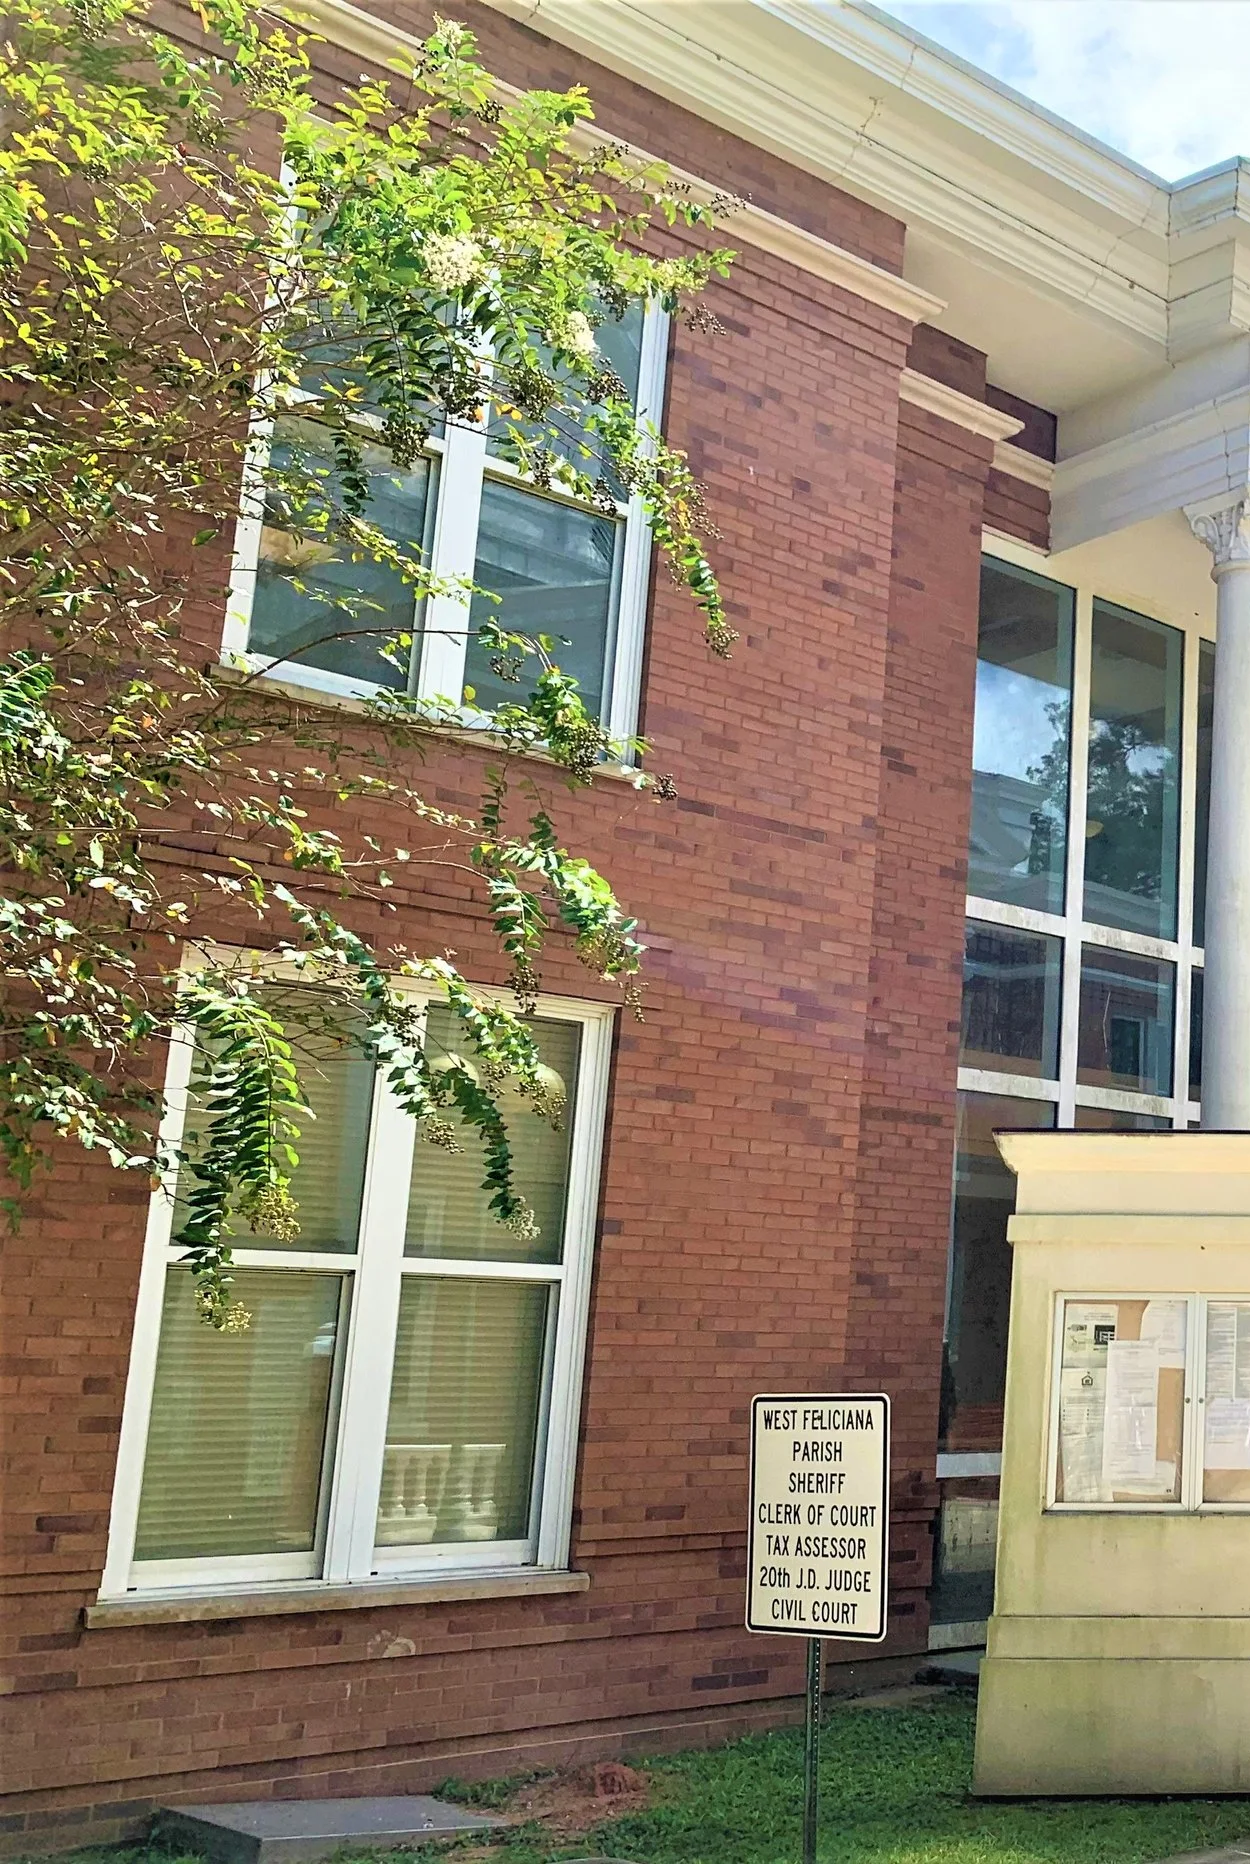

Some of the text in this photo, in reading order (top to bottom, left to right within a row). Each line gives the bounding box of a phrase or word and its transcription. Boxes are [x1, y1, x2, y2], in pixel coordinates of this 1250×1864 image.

[763, 1409, 874, 1431] WEST FELICIANA
[792, 1441, 843, 1462] PARISH
[788, 1472, 846, 1494] SHERIFF
[758, 1503, 877, 1527] CLERK OF COURT
[766, 1534, 867, 1560] TAX ASSESSOR
[759, 1566, 872, 1593] 20th J.D. JUDGE
[771, 1598, 858, 1625] CIVIL COURT
